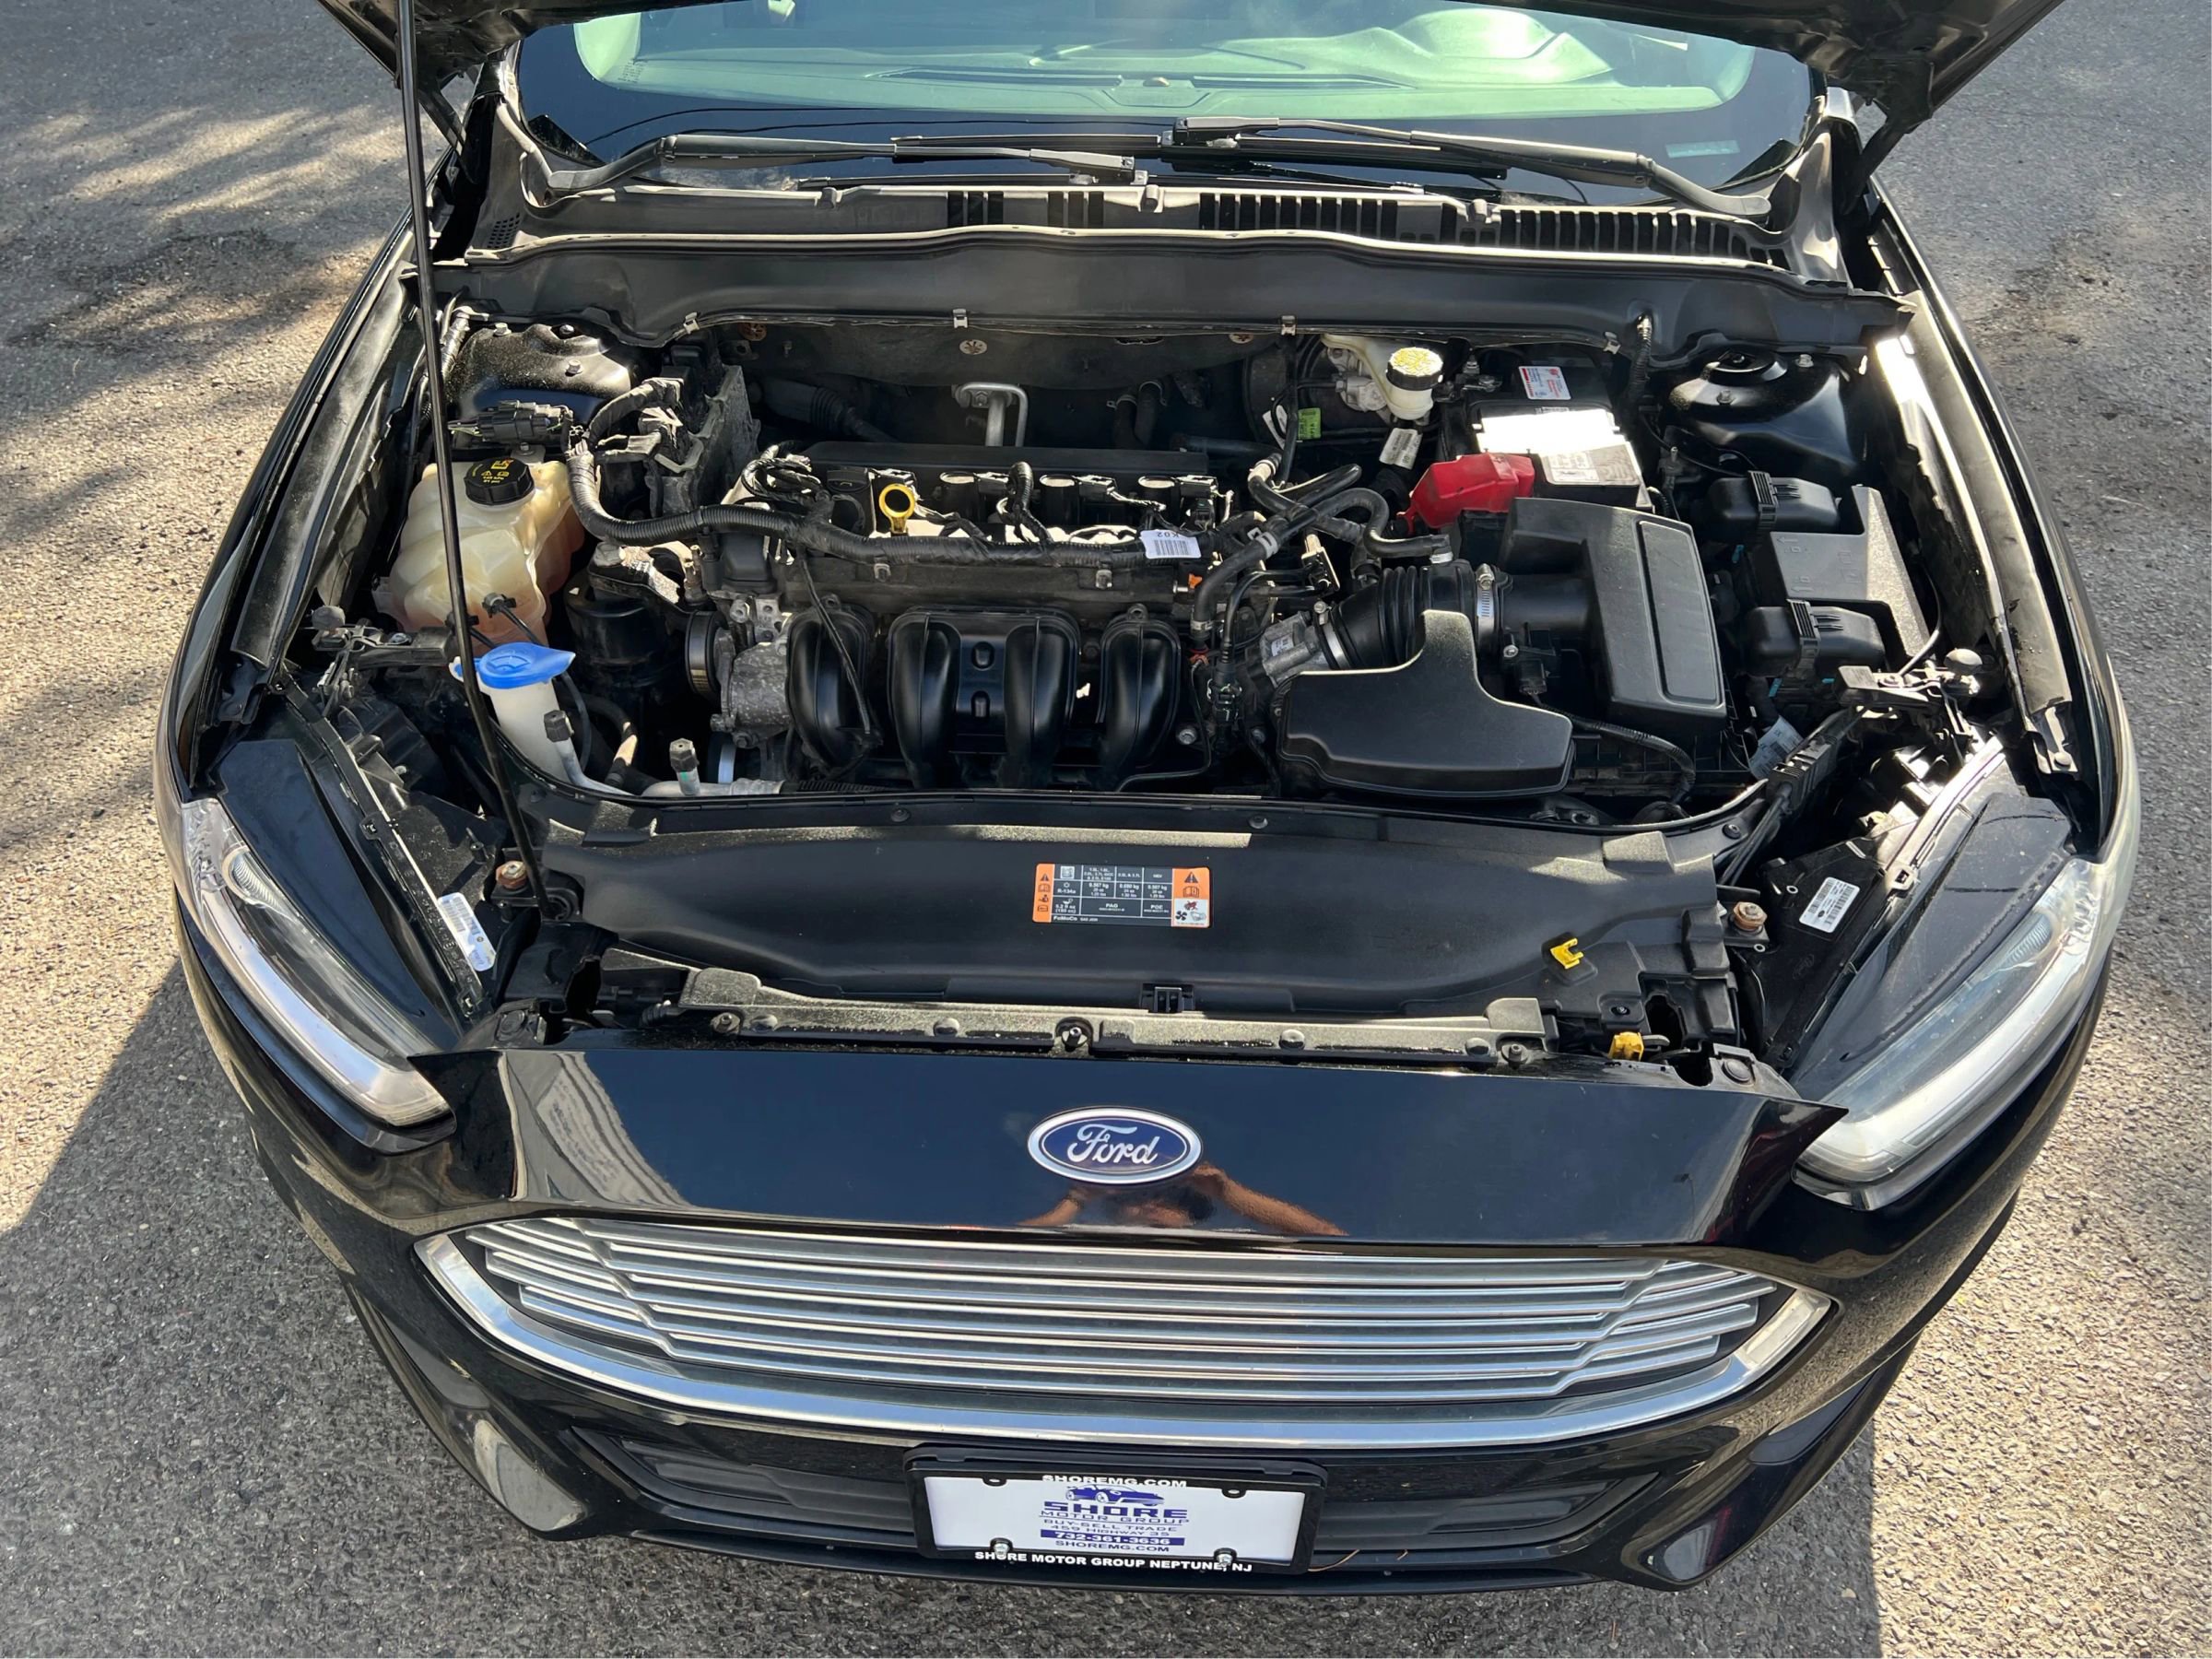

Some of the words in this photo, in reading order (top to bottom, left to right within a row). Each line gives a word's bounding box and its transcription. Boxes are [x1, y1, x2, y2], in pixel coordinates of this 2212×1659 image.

[1067, 1124, 1160, 1165] Ford
[1042, 1475, 1187, 1487] SHOREMG.COM
[1044, 1501, 1187, 1518] SHORE
[1041, 1511, 1108, 1521] MOTOR
[1086, 1527, 1145, 1536] HIGHWAY
[1055, 1540, 1170, 1552] SHOREMG.COM
[1031, 1554, 1087, 1565] MOTOR
[1091, 1557, 1145, 1567] GROUP
[1232, 1563, 1253, 1572] NJ
